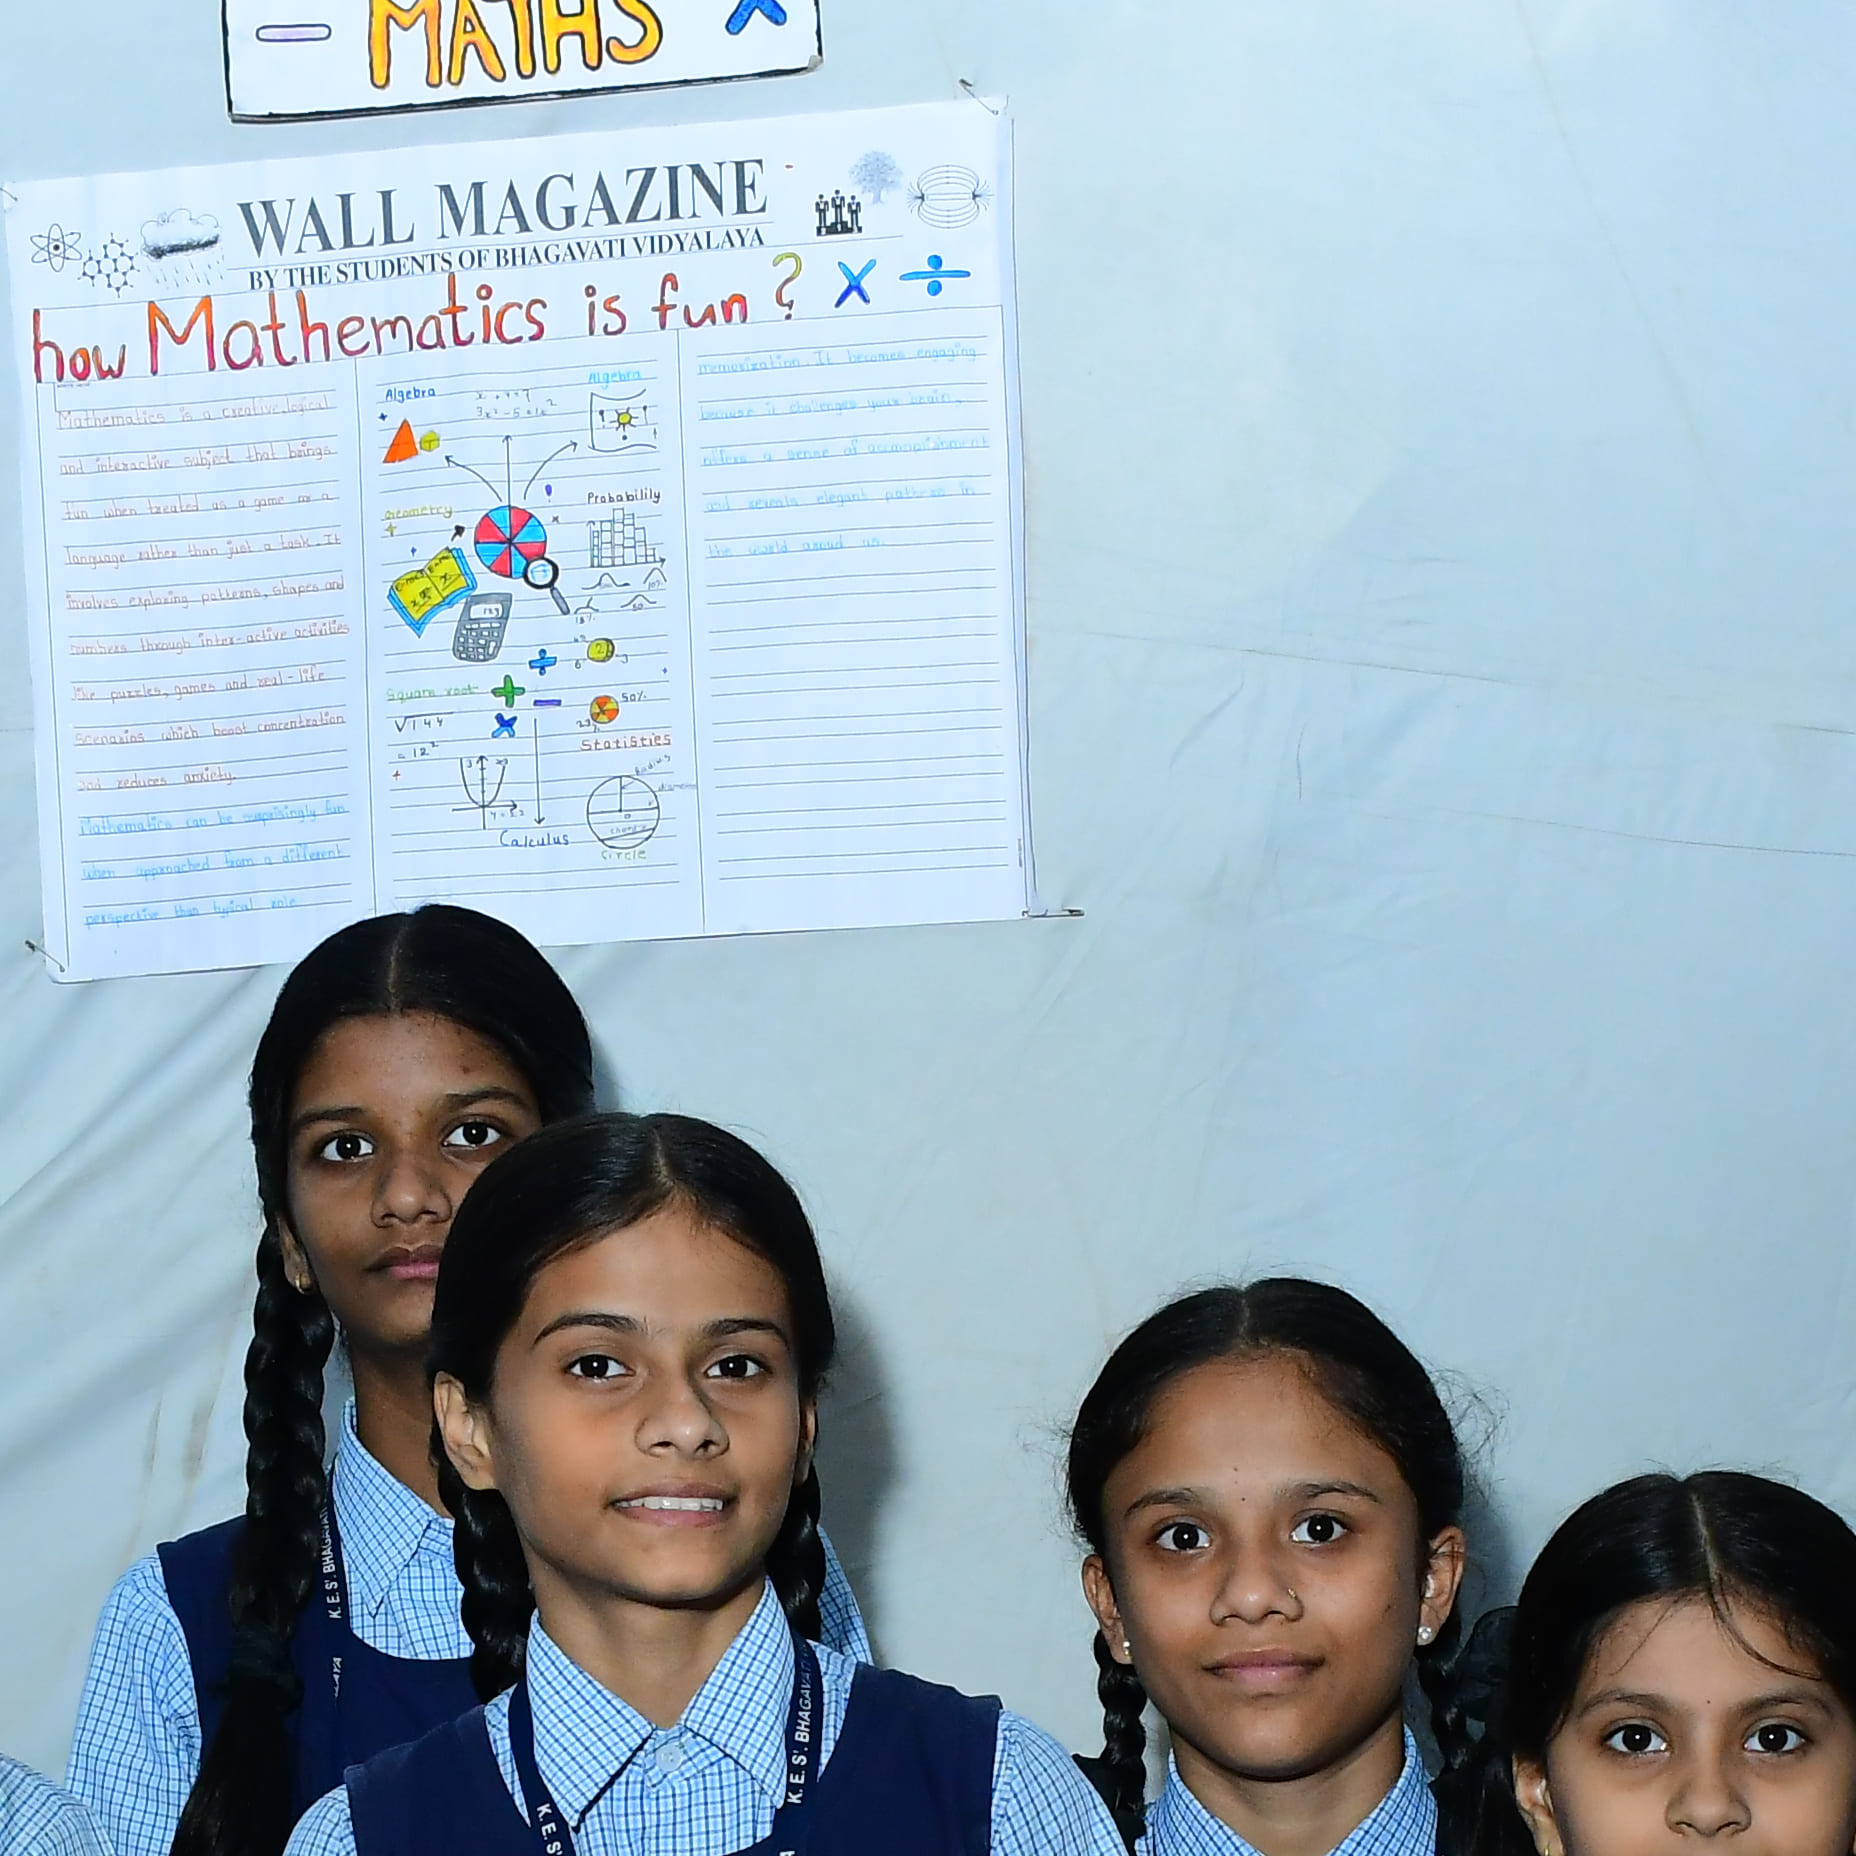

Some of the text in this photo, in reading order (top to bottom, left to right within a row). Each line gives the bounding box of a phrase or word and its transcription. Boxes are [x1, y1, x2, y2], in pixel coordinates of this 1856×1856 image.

[369, 0, 663, 88] MATHS
[237, 157, 768, 260] WALL MAGAZINE
[249, 227, 766, 291] BY THE STUDENTS OF BHAGAVATI VIDYALAYA
[34, 253, 802, 382] how Mathematics is fun ?
[385, 386, 436, 404] Algebra
[500, 830, 569, 848] Calculus
